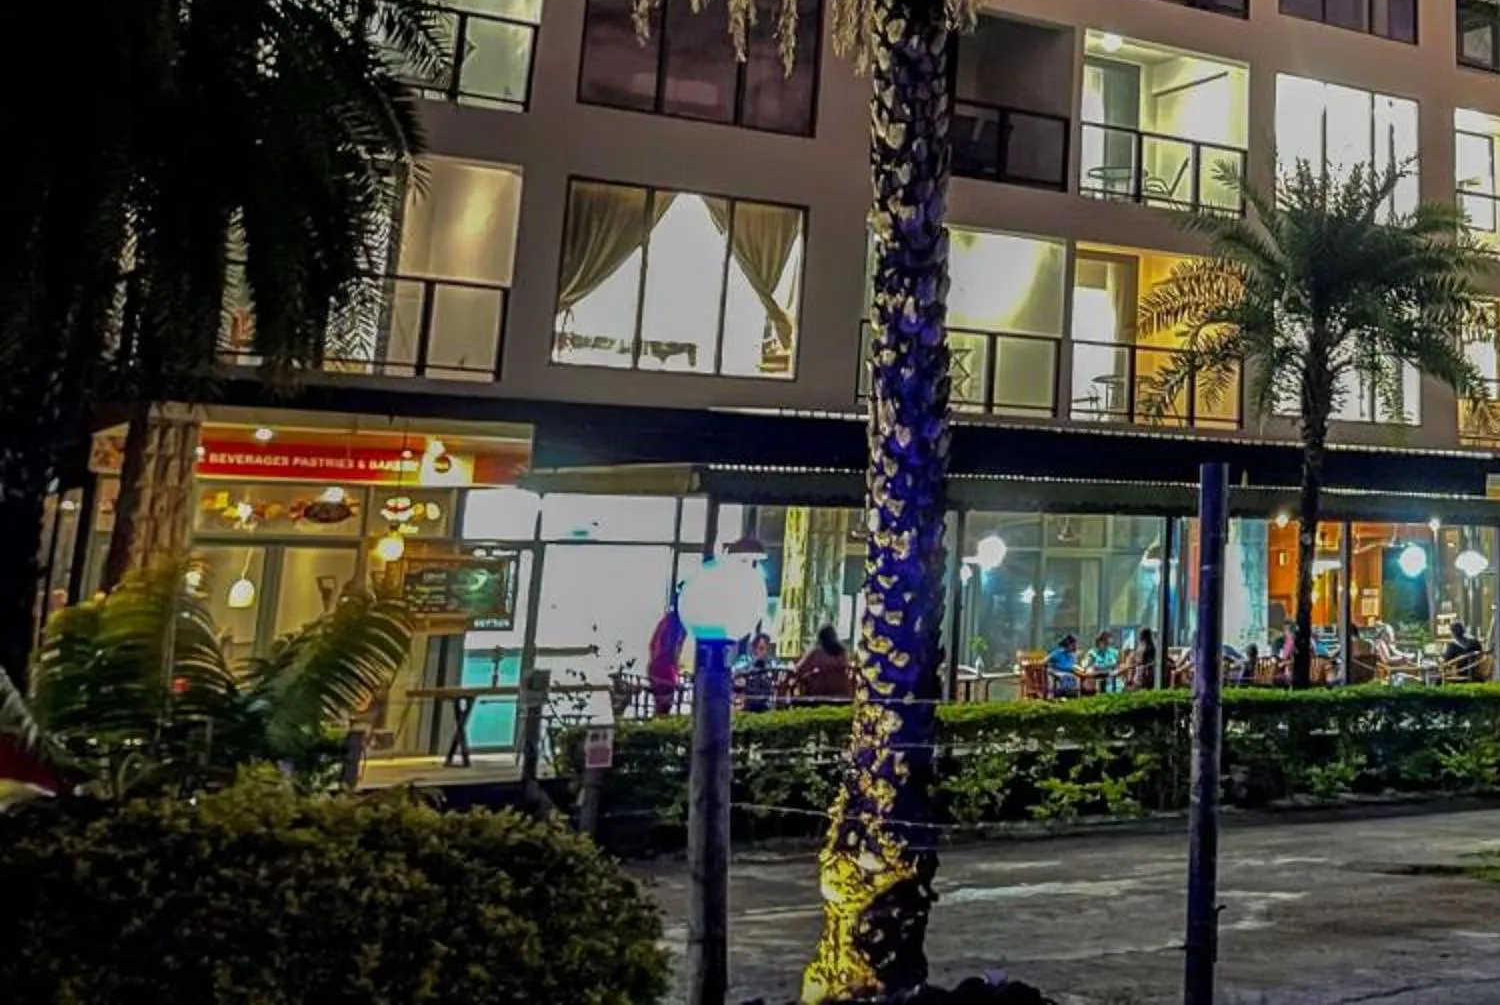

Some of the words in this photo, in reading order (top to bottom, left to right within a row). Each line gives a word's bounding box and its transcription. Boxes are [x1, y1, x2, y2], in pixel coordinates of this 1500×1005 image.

[208, 453, 289, 467] BEVERAGES
[292, 456, 354, 469] PASTRIES
[357, 458, 366, 470] &
